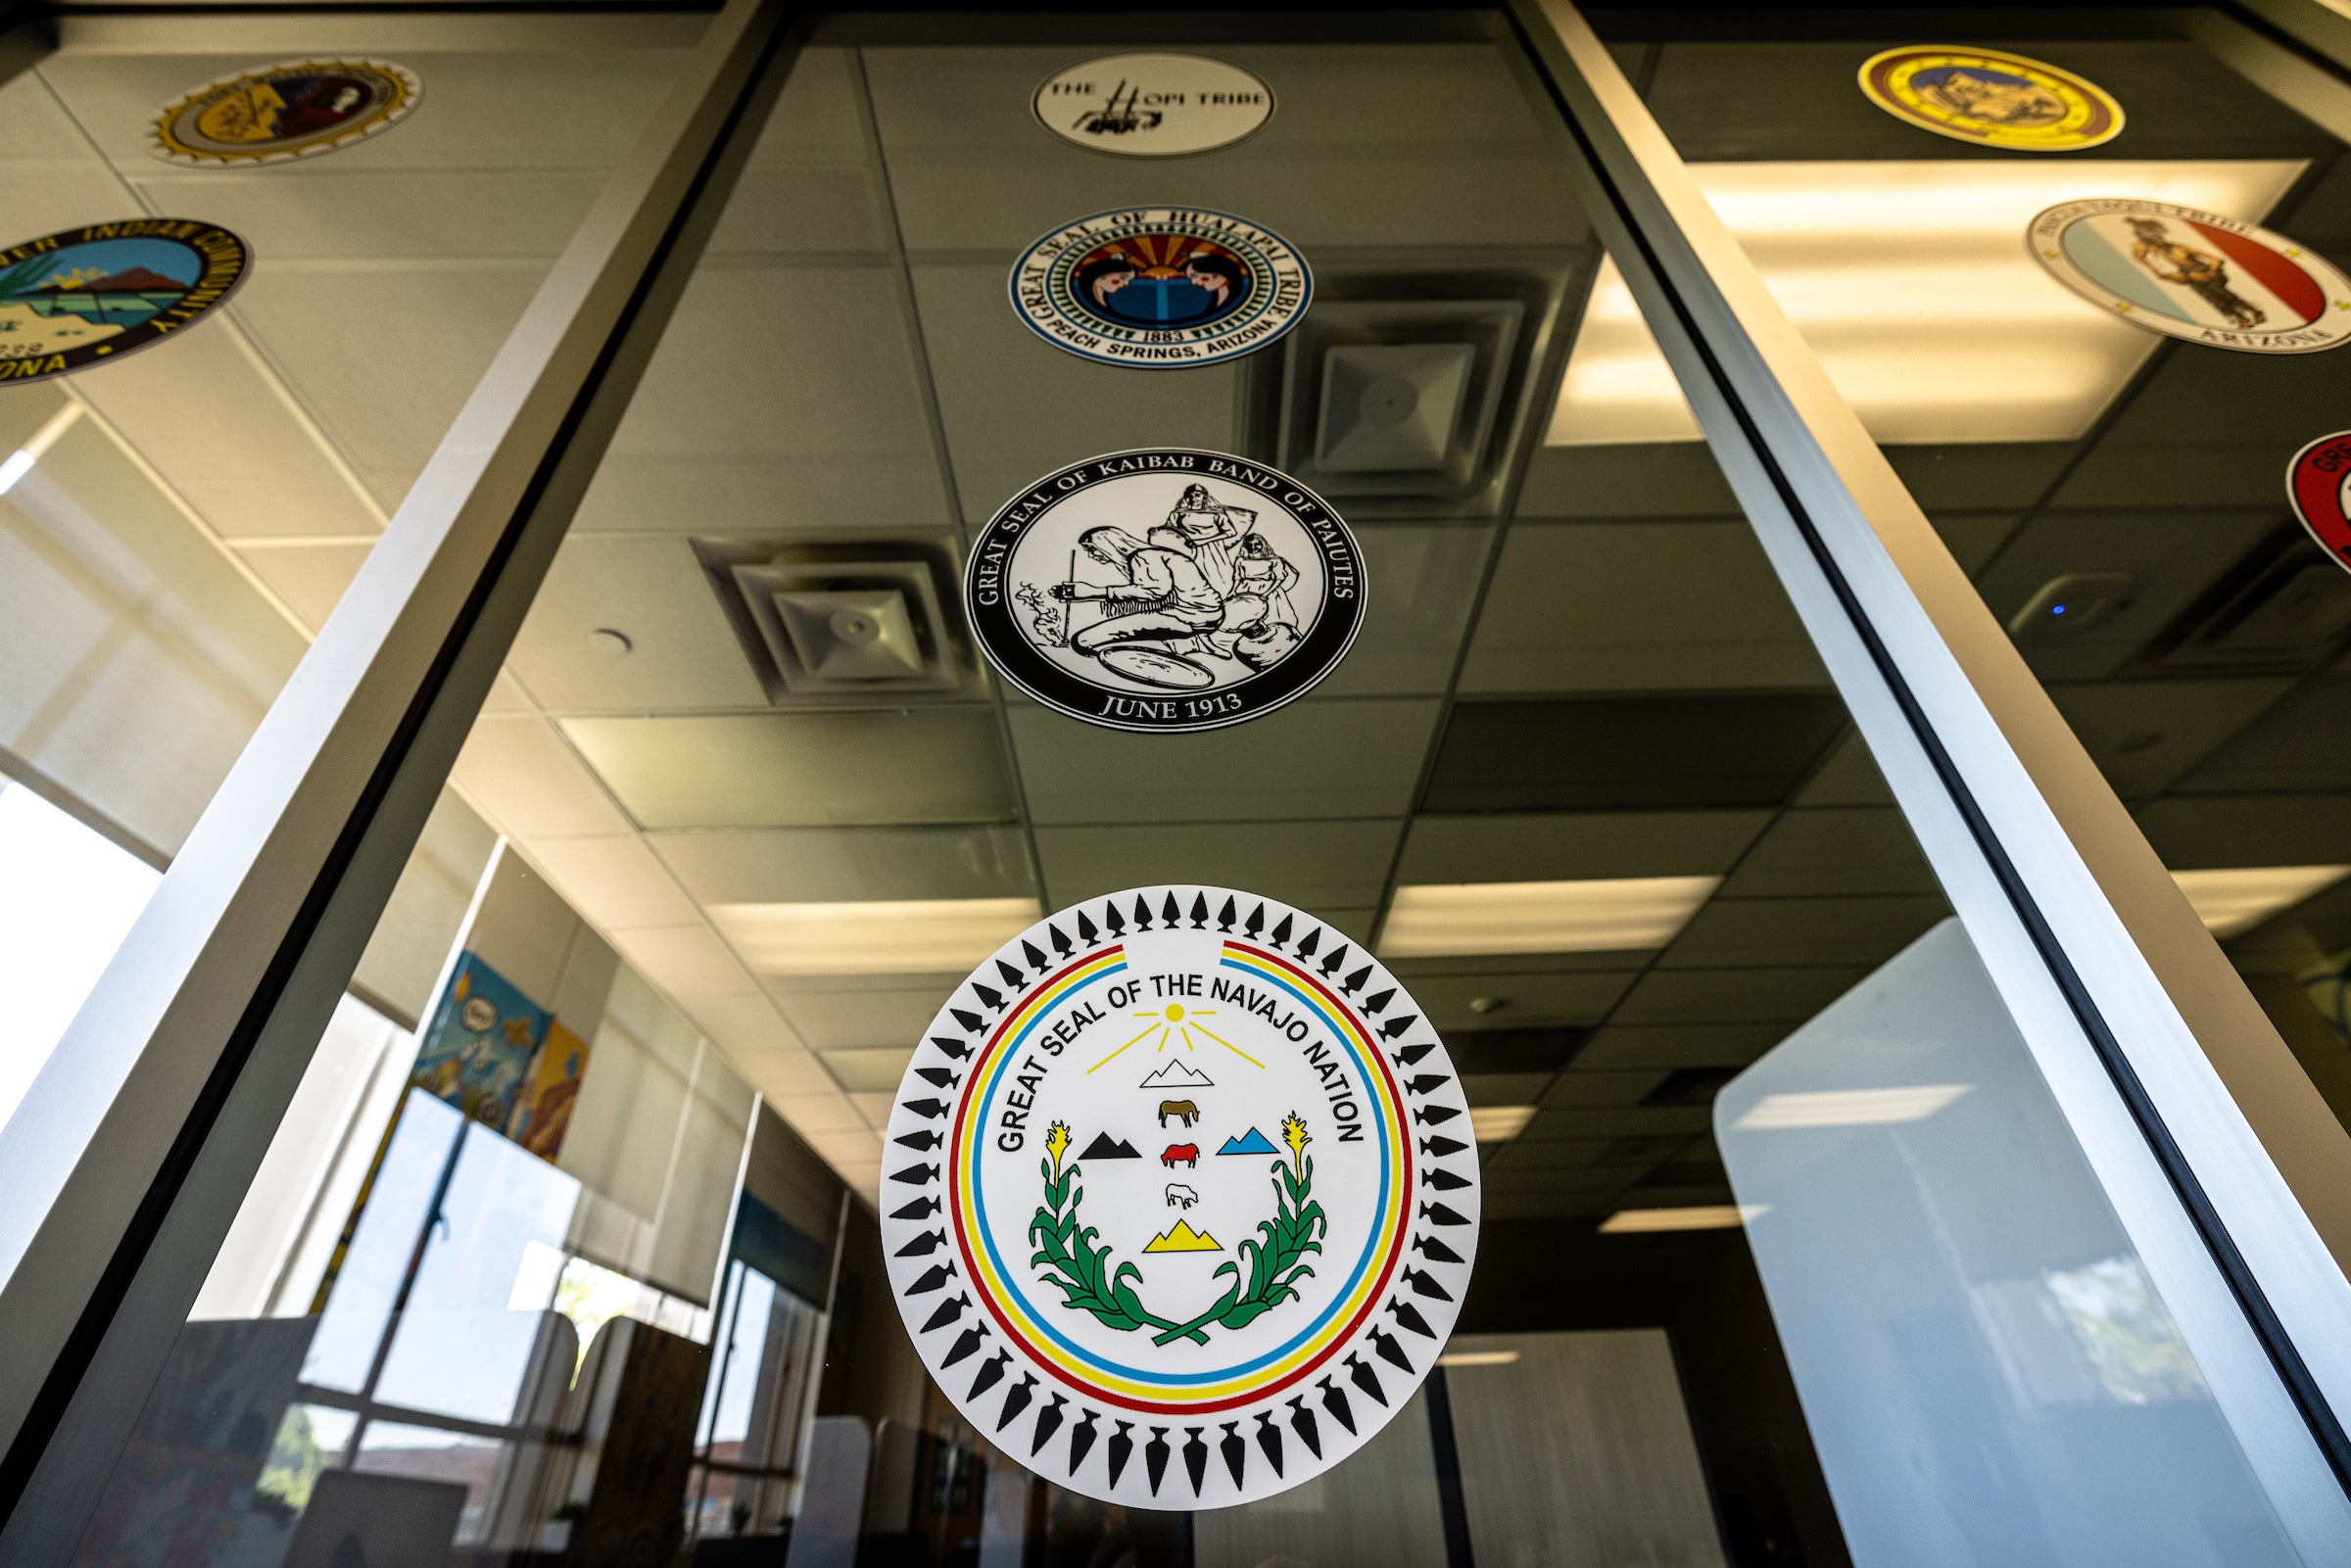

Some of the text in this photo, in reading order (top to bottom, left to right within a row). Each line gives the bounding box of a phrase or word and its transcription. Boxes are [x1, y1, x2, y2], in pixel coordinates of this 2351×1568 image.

[1052, 82, 1096, 95] THE
[1197, 92, 1267, 106] TRIBE
[1022, 211, 1302, 320] GREAT SEAL OF HUALAPAI TRIBE
[1046, 318, 1278, 359] PEACH SPRINGS, ARIZONA
[1143, 330, 1184, 343] 1883
[978, 454, 1355, 606] GREAT SEAL OF KAIBAB BAND OF PAIUTES
[1098, 691, 1243, 720] JUNE 1913
[997, 974, 1365, 1153] GREAT SEAL OF THE NAVAJO NATION
